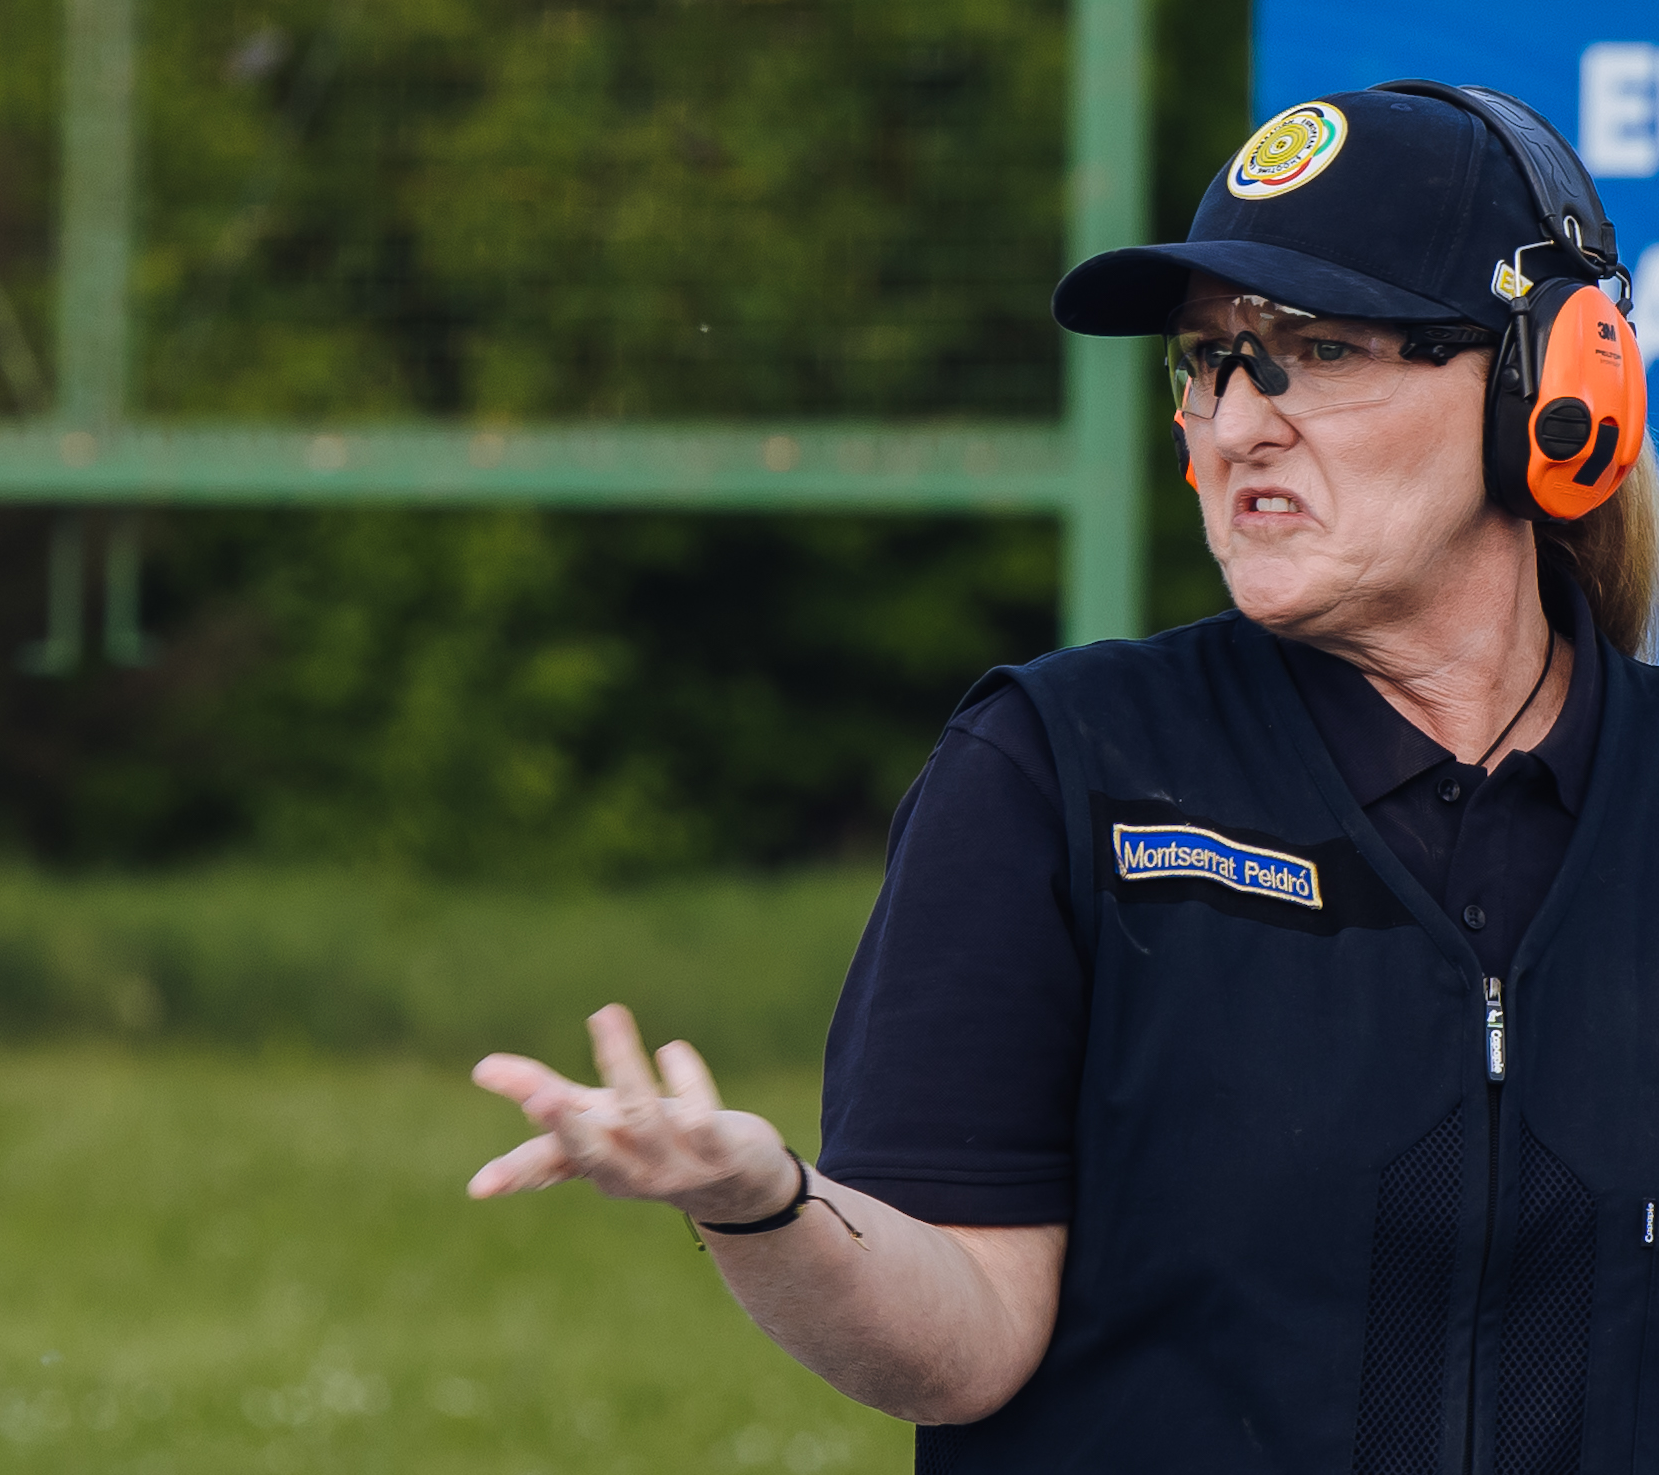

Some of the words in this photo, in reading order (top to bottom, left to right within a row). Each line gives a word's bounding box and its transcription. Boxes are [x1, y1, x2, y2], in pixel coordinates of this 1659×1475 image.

[1597, 321, 1617, 342] 3M
[1124, 840, 1238, 881] Montserrat
[1244, 859, 1310, 897] Peldró
